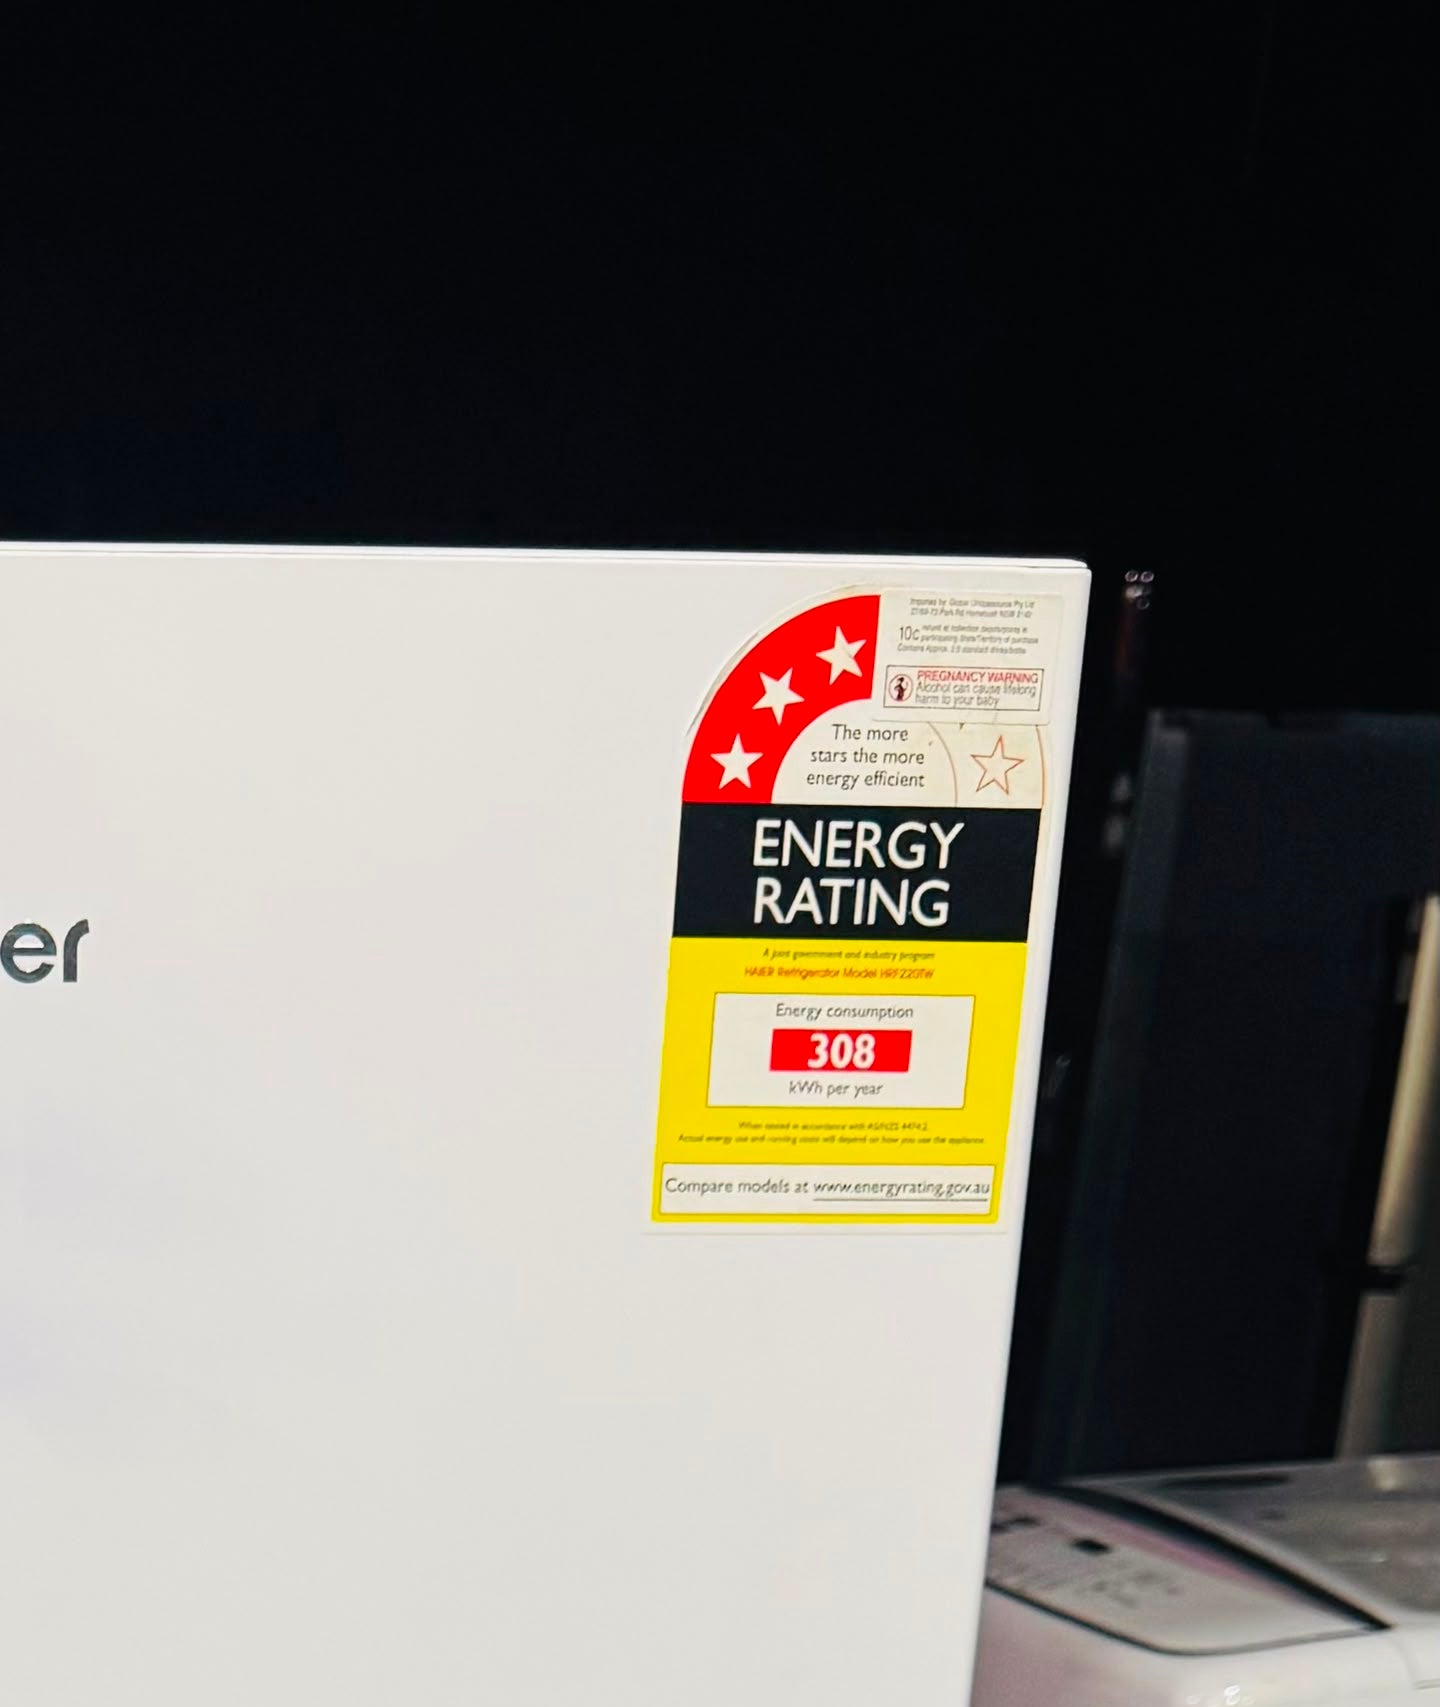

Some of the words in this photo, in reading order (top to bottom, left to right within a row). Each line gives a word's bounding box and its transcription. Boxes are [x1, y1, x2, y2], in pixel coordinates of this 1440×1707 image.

[899, 625, 920, 641] 10c
[917, 670, 985, 683] PREGNANCY
[988, 672, 1039, 684] WARNING
[916, 682, 952, 694] Alcohol
[954, 684, 970, 694] can
[974, 685, 1001, 695] cause
[1003, 683, 1037, 698] lifelong
[915, 693, 939, 704] harm
[942, 694, 950, 705] to
[953, 696, 973, 709] your
[976, 694, 1000, 707] baby
[832, 723, 861, 741] The
[866, 729, 909, 741] more
[810, 750, 848, 763] stars
[853, 747, 878, 763] the
[883, 752, 925, 765] more
[806, 772, 860, 791] energy
[864, 770, 925, 787] efficient
[753, 818, 965, 870] ENERGY
[754, 876, 951, 927] RATING
[745, 966, 774, 977] HAIER
[777, 966, 840, 981] Refrigerator
[843, 967, 877, 978] Model
[775, 1003, 822, 1021] Energy
[826, 1005, 914, 1021] consumption
[807, 1032, 876, 1069] 308
[788, 1080, 823, 1095] kWh
[826, 1083, 849, 1098] per
[854, 1084, 883, 1099] year
[665, 1177, 733, 1196] Compare
[737, 1178, 789, 1194] models
[794, 1181, 809, 1194] at
[814, 1180, 990, 1198] www.energyrating.gov.au
